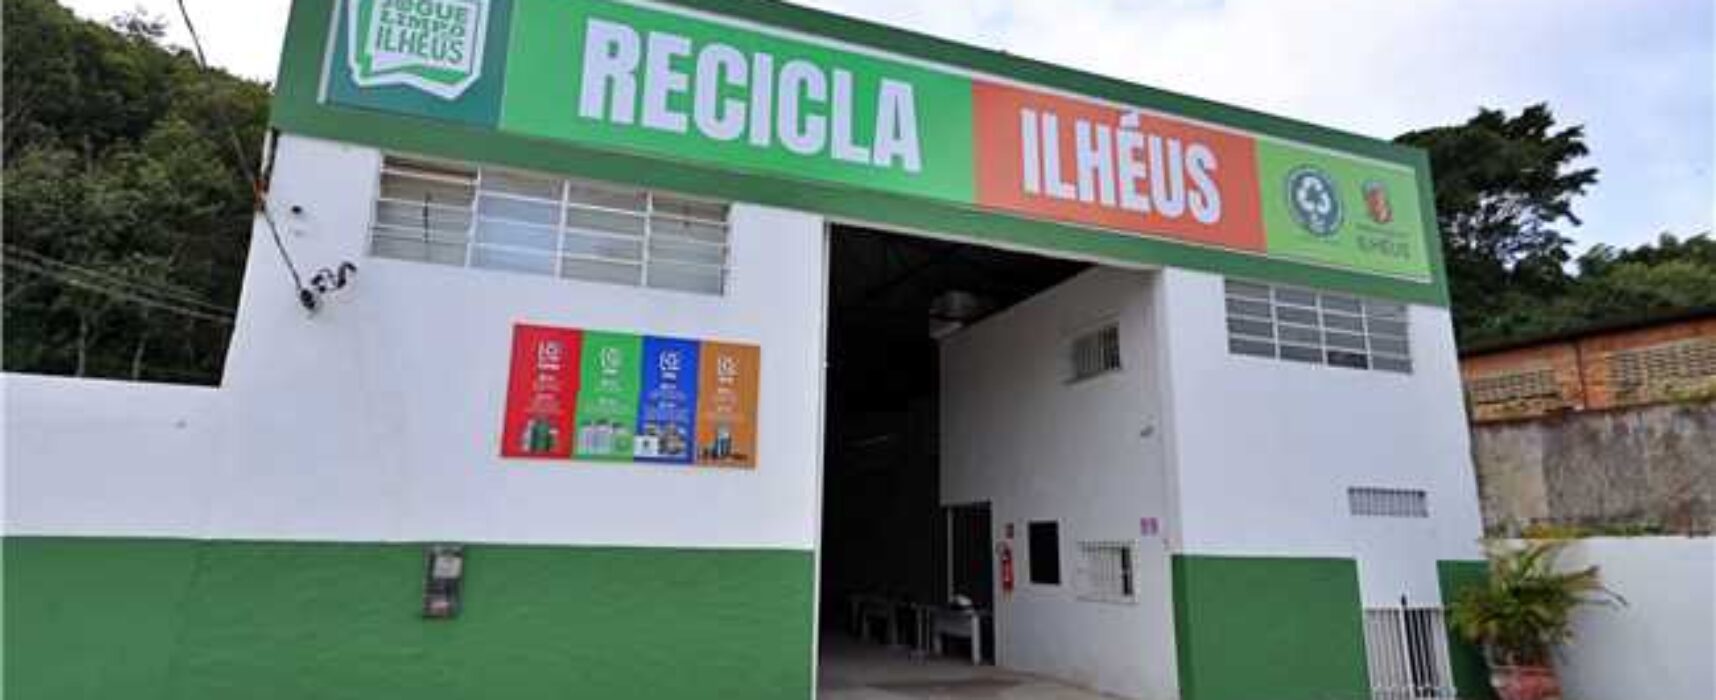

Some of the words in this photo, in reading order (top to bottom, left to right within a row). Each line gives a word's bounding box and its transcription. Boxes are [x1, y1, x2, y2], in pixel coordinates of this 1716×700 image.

[379, 10, 465, 37] LIMPO
[579, 20, 921, 173] RECICLA
[1021, 107, 1222, 225] ILHÉUS
